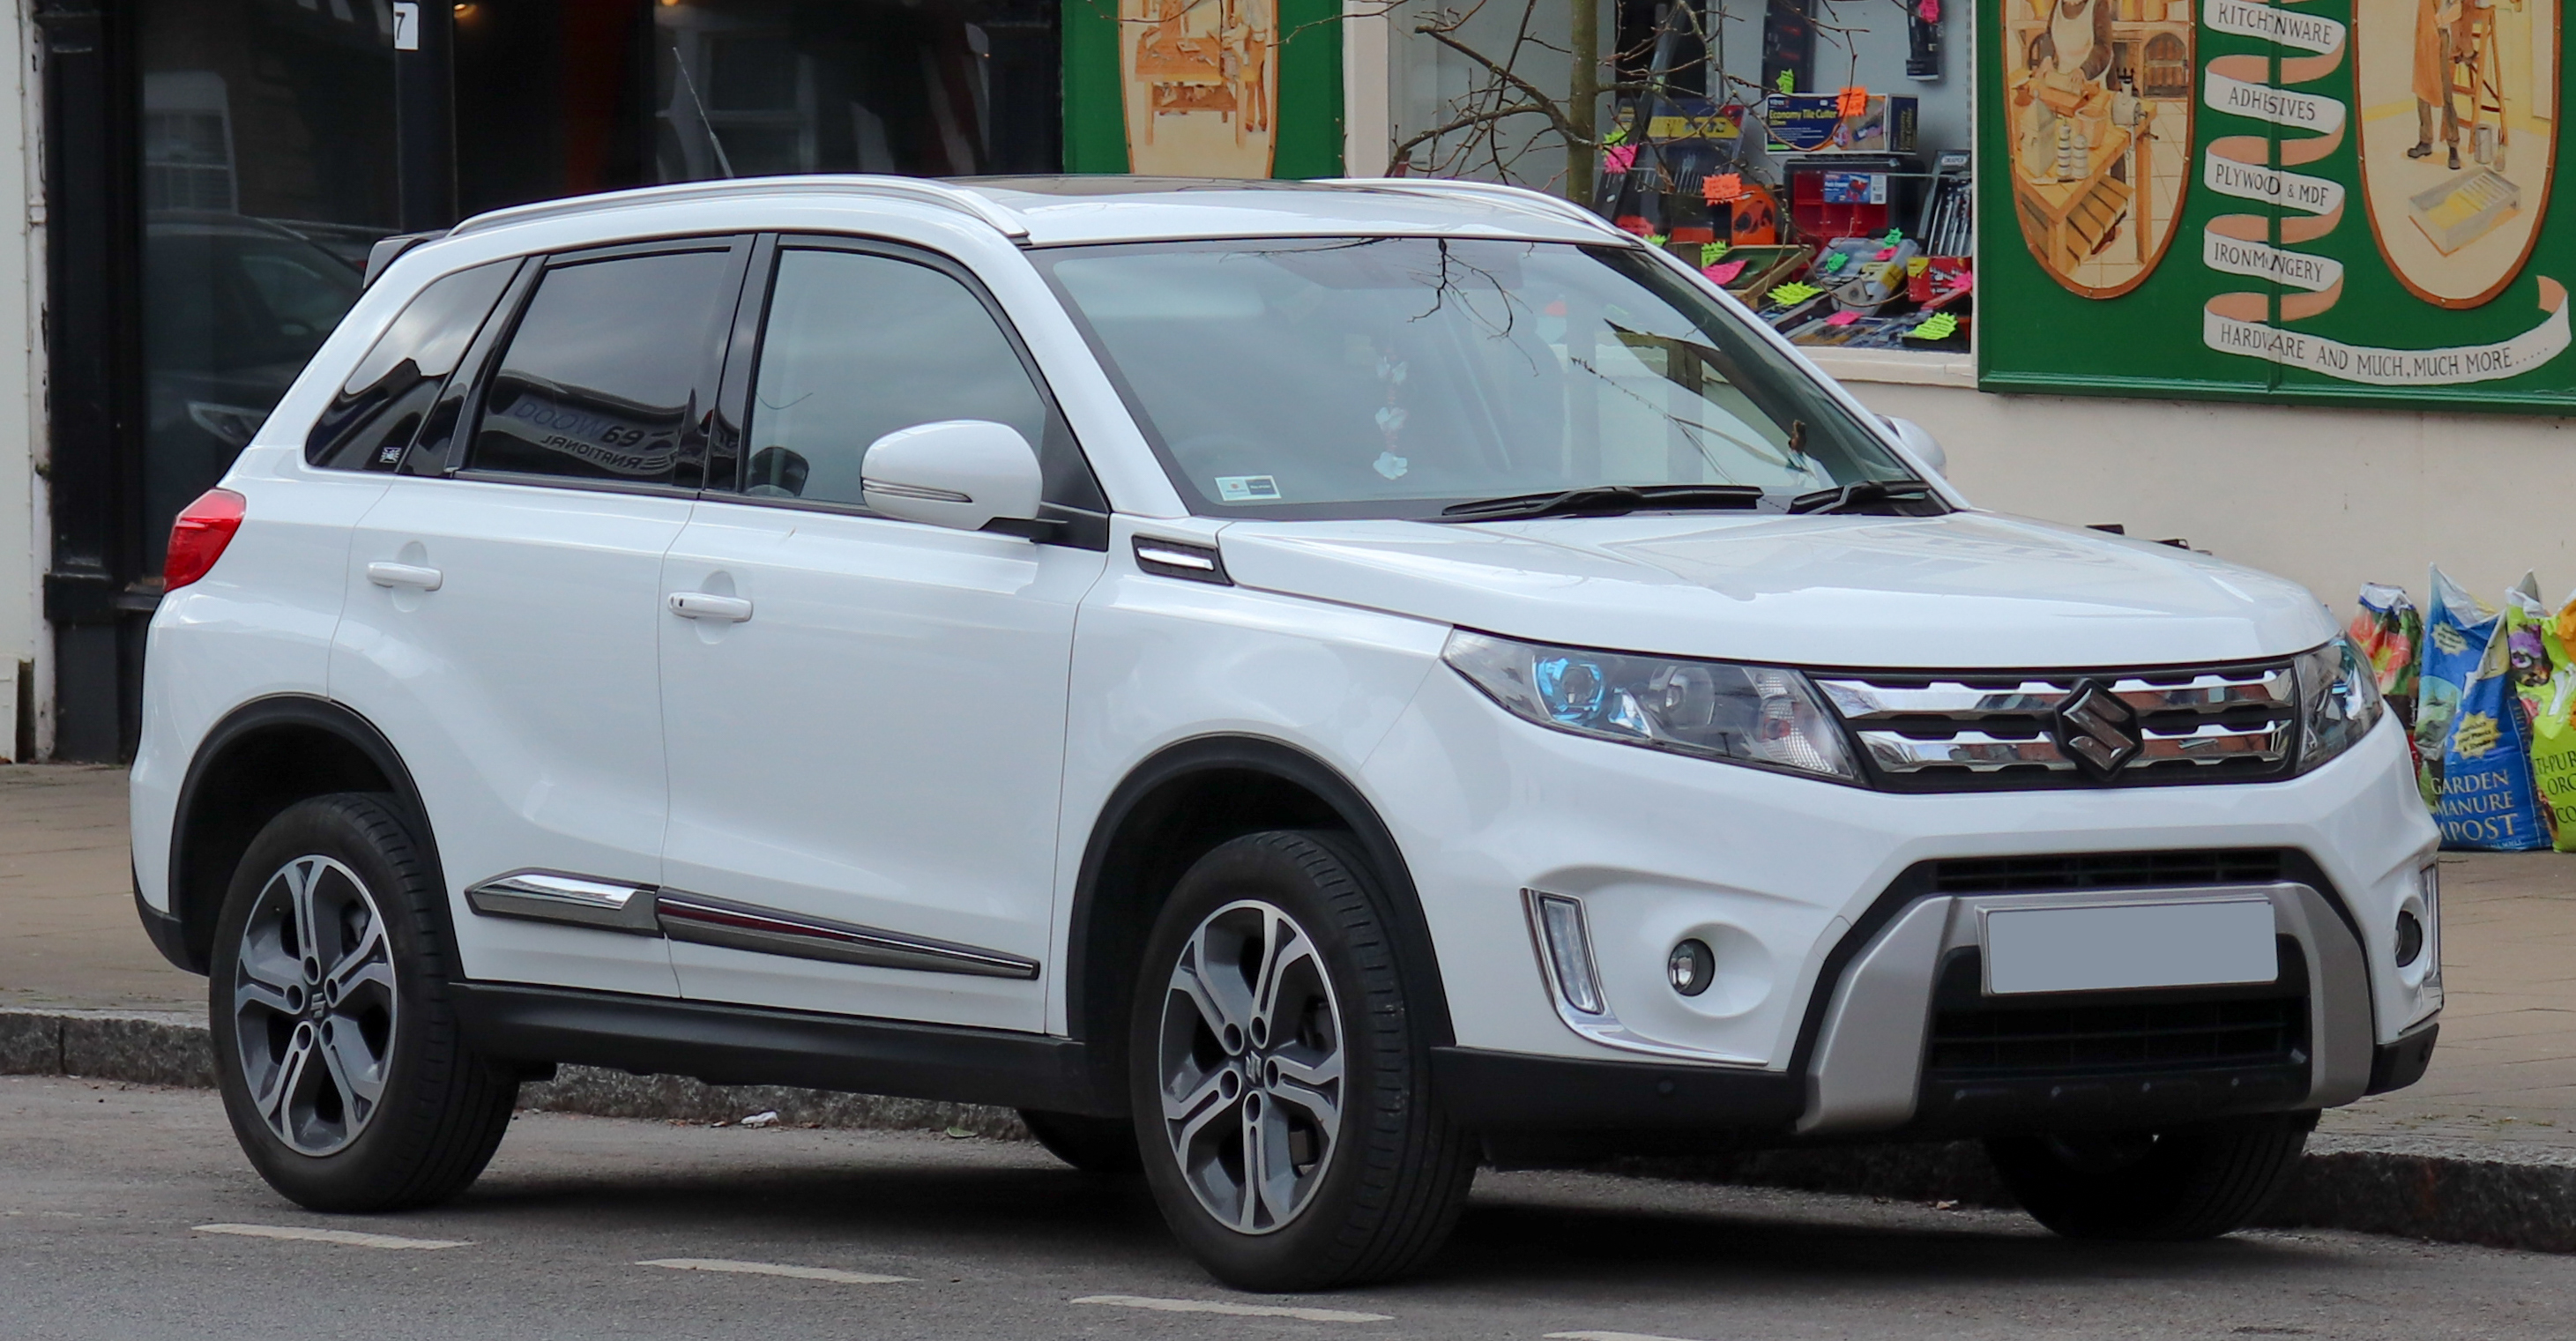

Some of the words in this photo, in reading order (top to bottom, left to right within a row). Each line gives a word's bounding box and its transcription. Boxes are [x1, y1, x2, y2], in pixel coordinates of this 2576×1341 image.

[395, 11, 406, 40] 7
[2218, 3, 2332, 45] KITCHNWARE
[1768, 109, 1802, 121] Economy
[1803, 108, 1815, 118] Tile
[1816, 108, 1837, 118] Cutter
[2228, 86, 2316, 121] ADHESIVES
[2287, 184, 2294, 198] &
[2299, 184, 2329, 206] MDF
[2214, 242, 2324, 283] IRONMNGERY
[2316, 346, 2349, 370] AND
[2414, 354, 2460, 376] MUCH
[2431, 769, 2509, 795] GARDEN
[2434, 791, 2514, 816] MANURE
